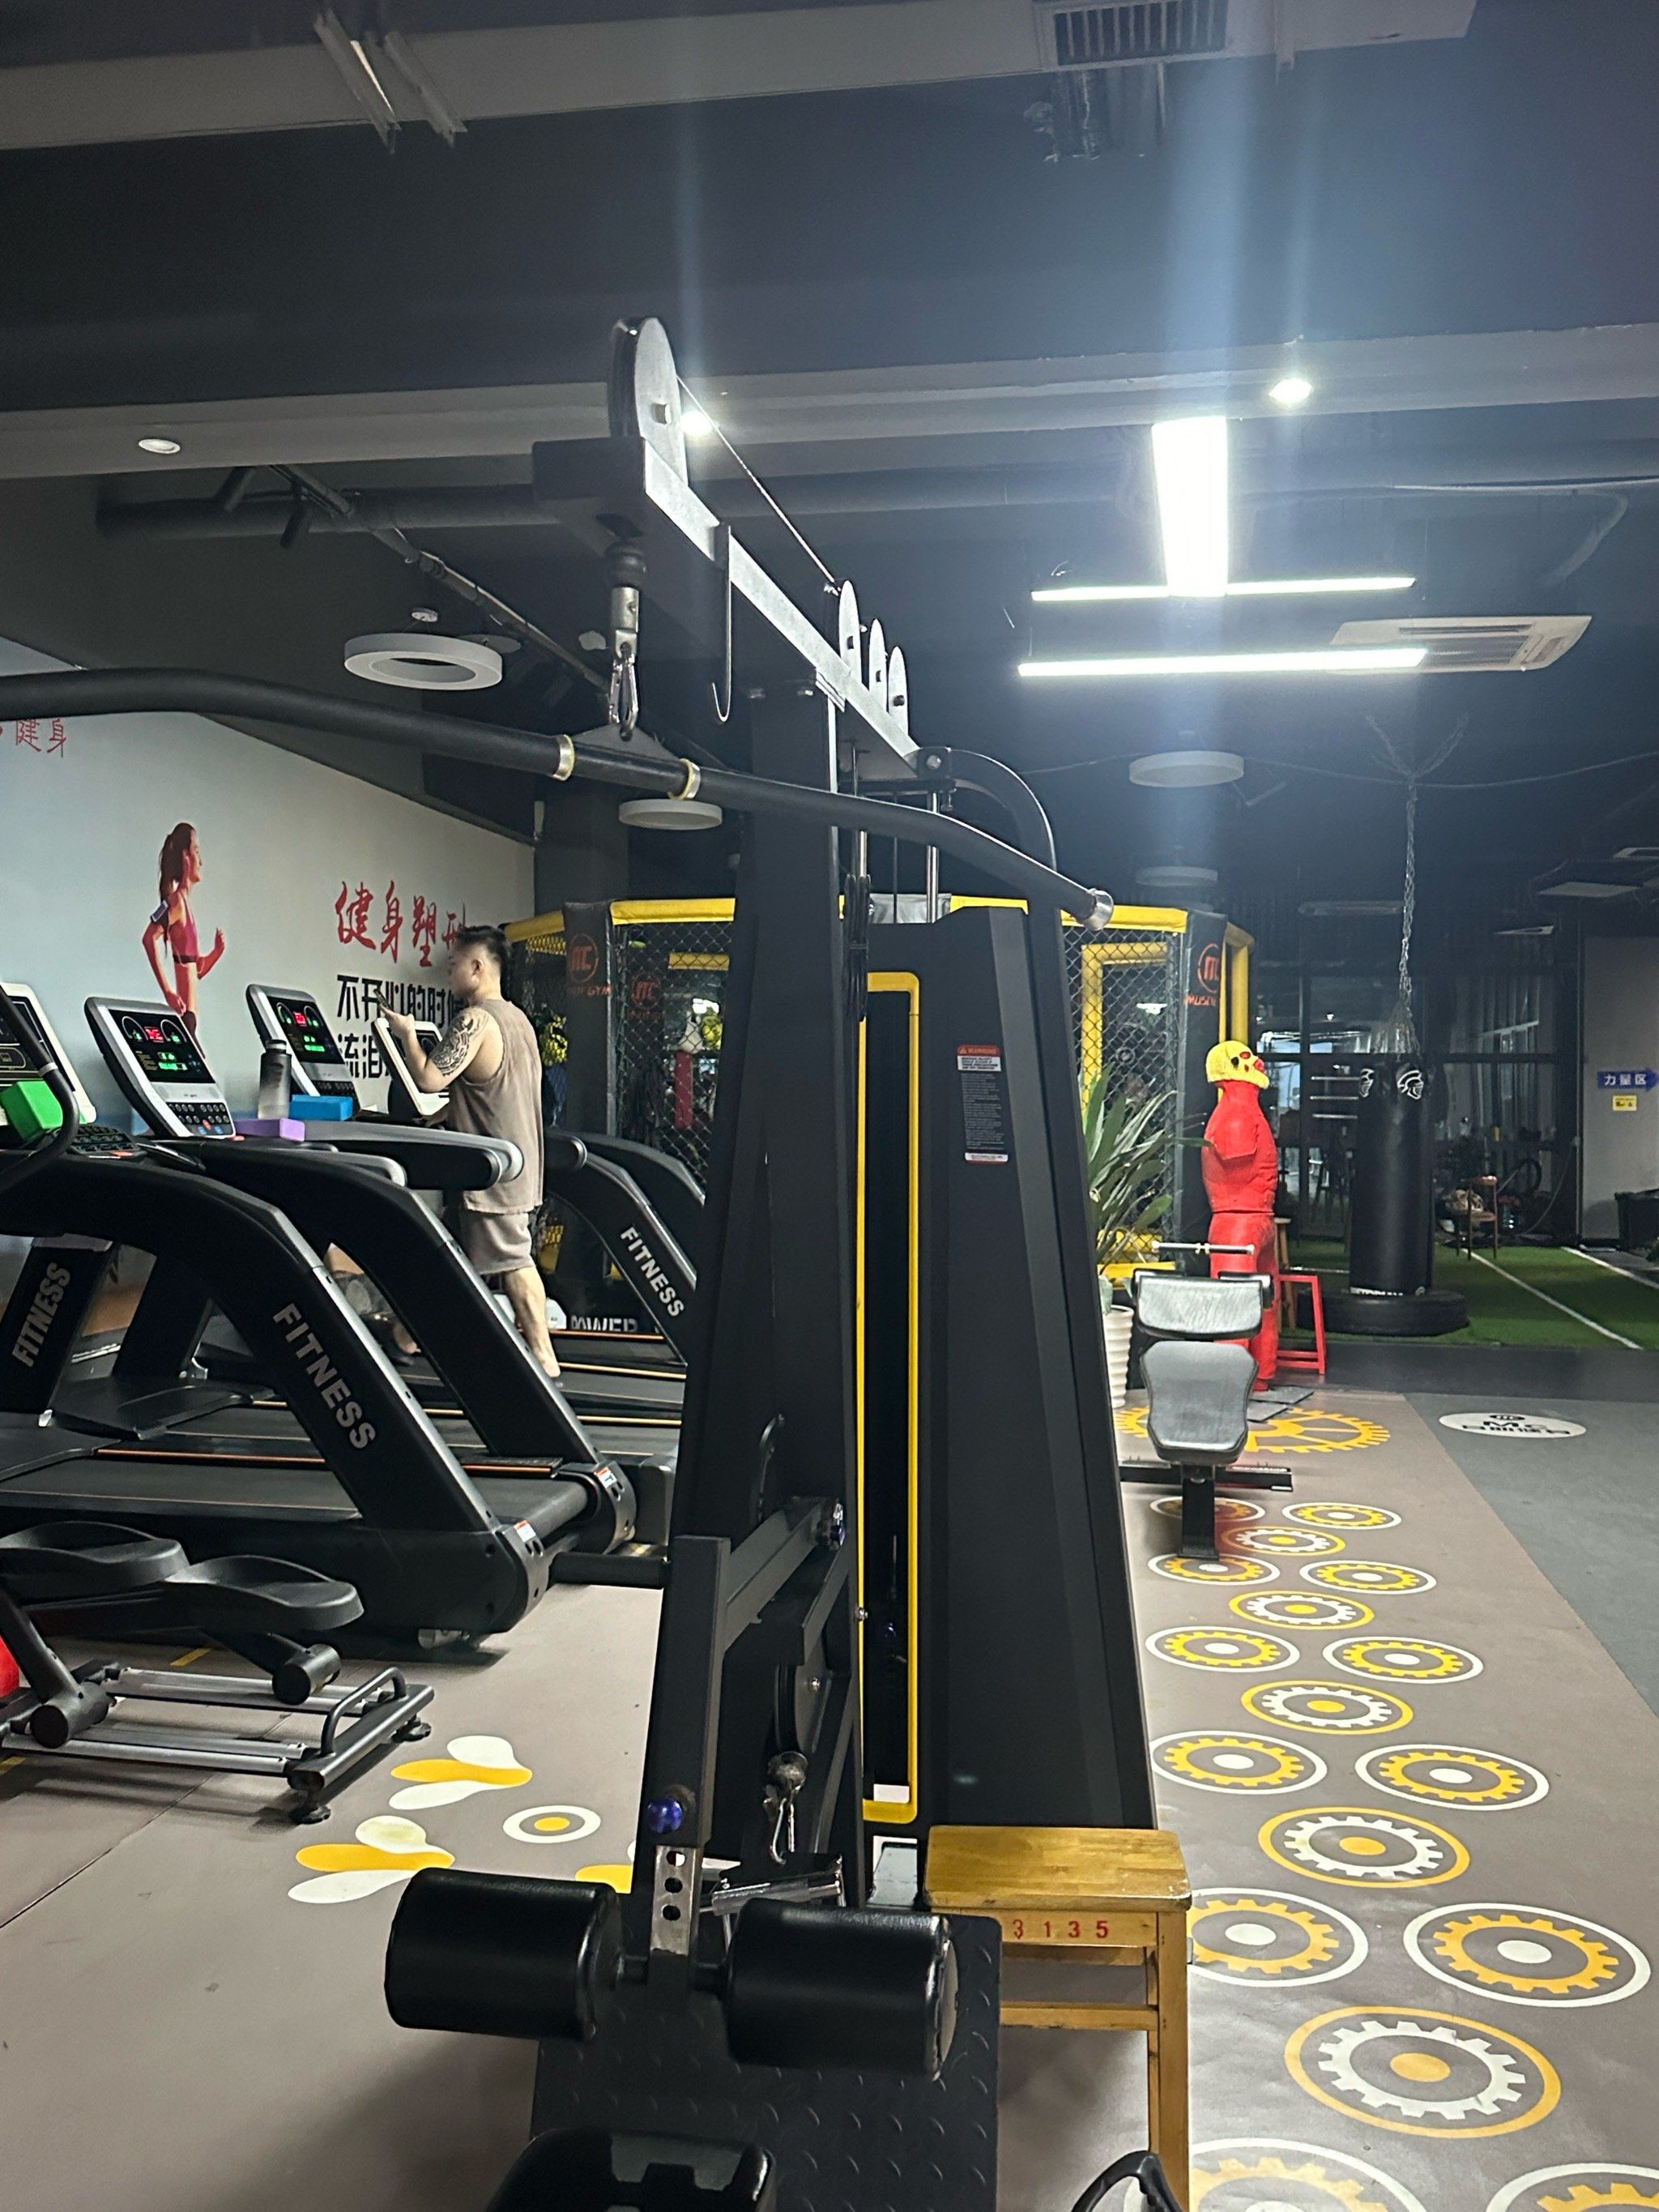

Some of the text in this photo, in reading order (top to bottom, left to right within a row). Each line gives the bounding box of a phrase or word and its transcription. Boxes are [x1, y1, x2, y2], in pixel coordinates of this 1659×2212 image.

[338, 1033, 390, 1079] 流泪
[1604, 1074, 1647, 1086] 力量区
[11, 1262, 70, 1367] FITNESS
[620, 1227, 684, 1317] FITNESS
[273, 1303, 376, 1449] FITNESS
